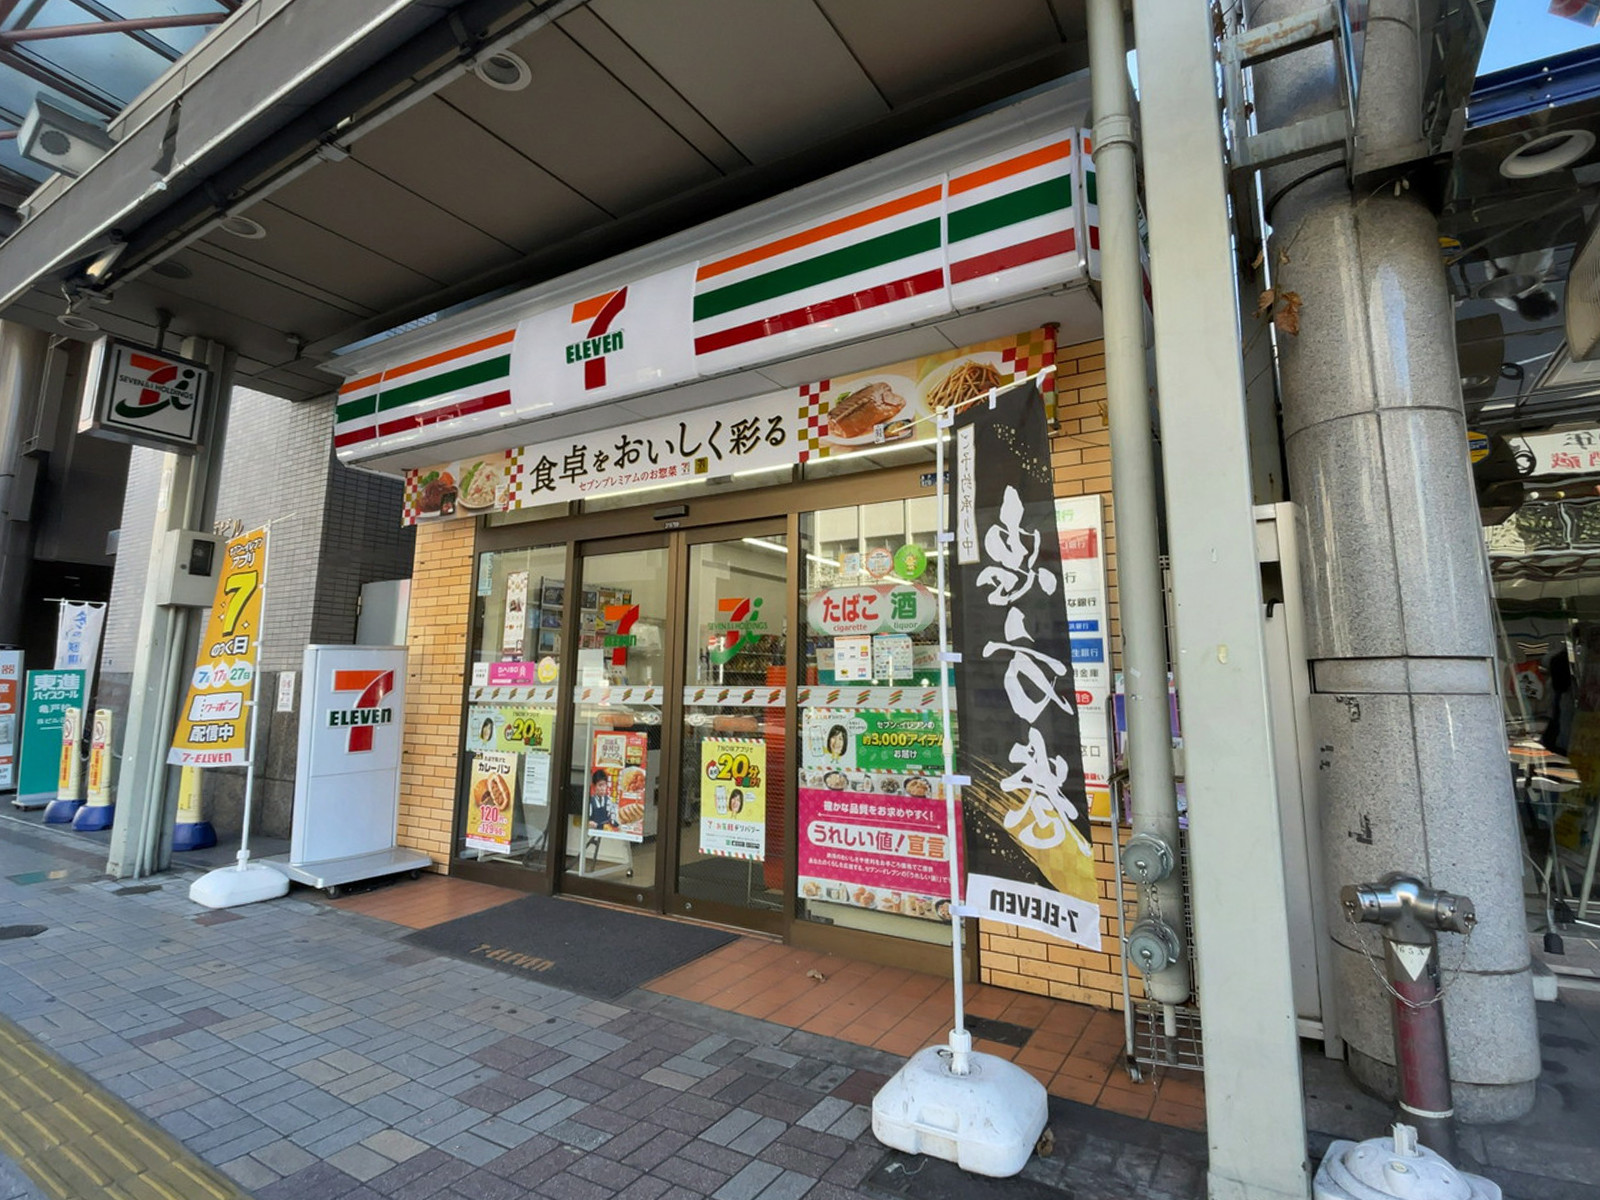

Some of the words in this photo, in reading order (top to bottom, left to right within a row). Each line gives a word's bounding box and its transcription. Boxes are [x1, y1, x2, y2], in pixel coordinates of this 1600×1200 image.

[155, 384, 194, 400] HOLDINGS
[529, 414, 787, 495] 食卓をおいしく彩る
[578, 464, 678, 492] セブンプレミアムのお惣菜
[230, 551, 256, 570] アプリ
[224, 569, 259, 638] 7
[822, 593, 880, 623] たばこ
[890, 591, 918, 620] 酒
[832, 624, 868, 632] cigarette
[893, 621, 919, 631] liquor
[209, 634, 251, 658] のつく日
[33, 673, 80, 693] 東進
[230, 666, 251, 681] 27日
[32, 689, 79, 701] ハイスクール
[203, 699, 240, 714] クーポン
[187, 721, 235, 744] 配信中
[893, 749, 918, 759] お届け
[478, 762, 511, 774] カレーパン
